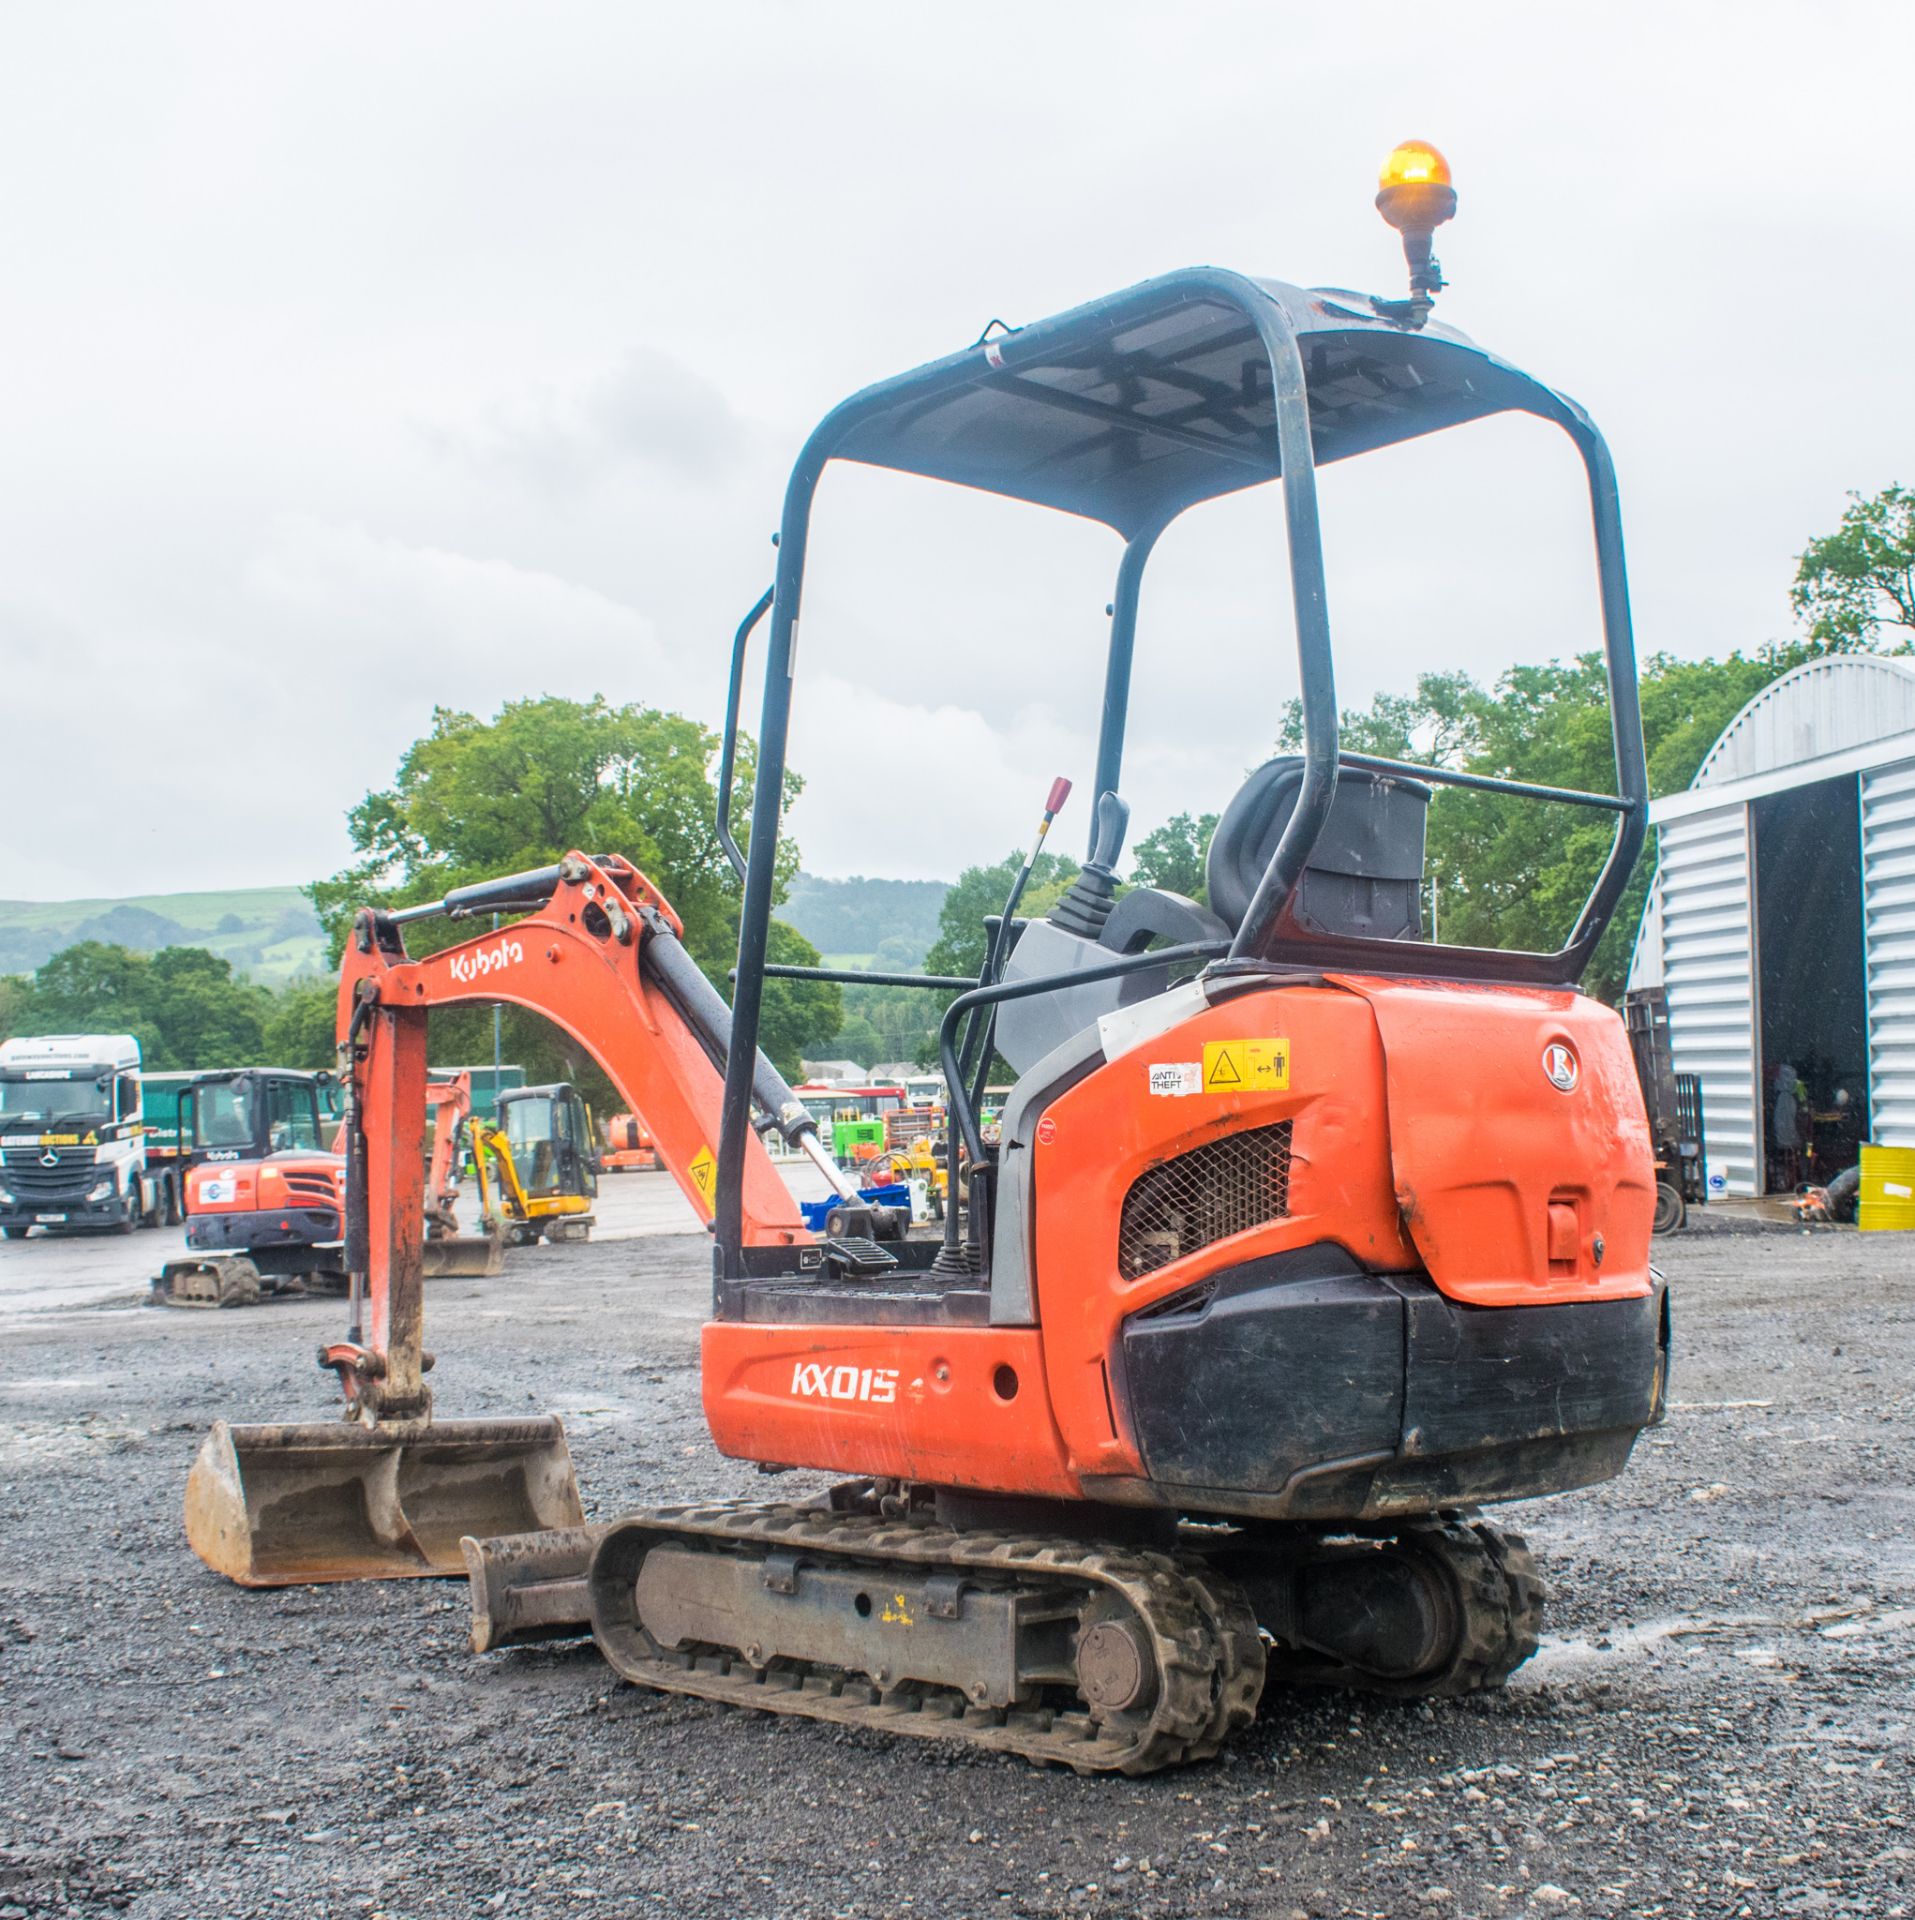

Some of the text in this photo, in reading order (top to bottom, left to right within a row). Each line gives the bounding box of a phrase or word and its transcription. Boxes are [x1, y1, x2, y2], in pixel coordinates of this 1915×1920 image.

[449, 938, 524, 983] Kubota
[1151, 1080, 1182, 1090] THEFT
[206, 1151, 239, 1161] Kubota
[790, 1362, 900, 1404] KX015
